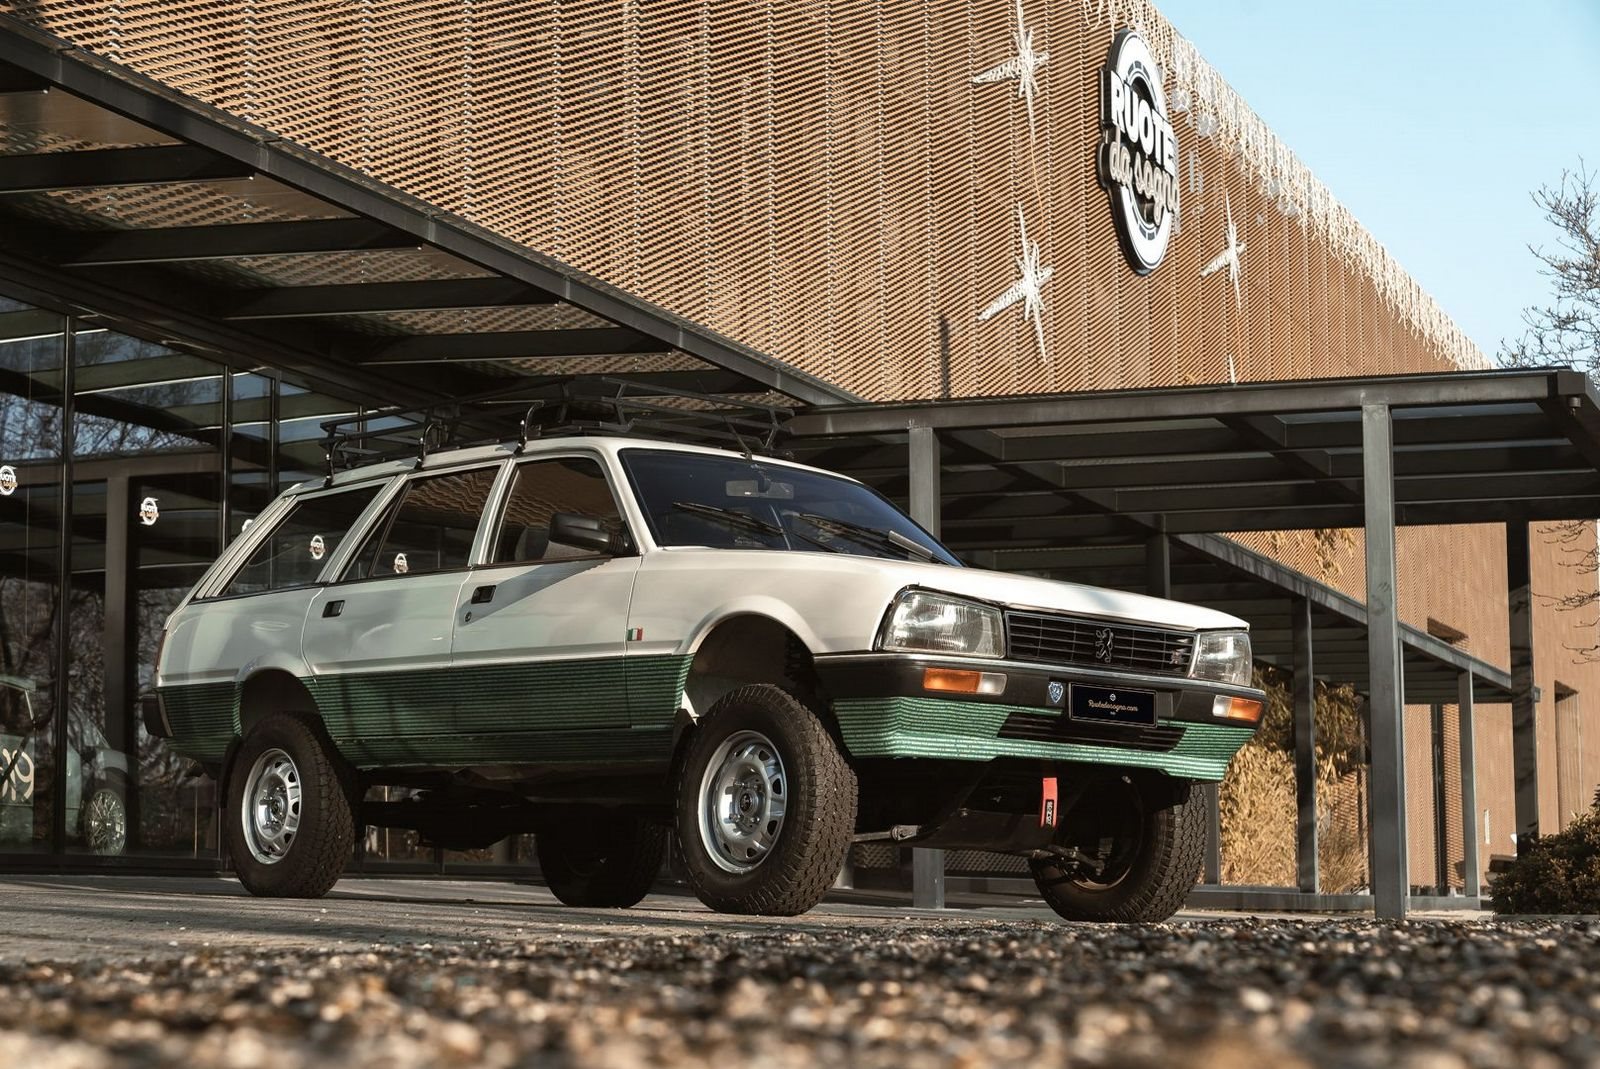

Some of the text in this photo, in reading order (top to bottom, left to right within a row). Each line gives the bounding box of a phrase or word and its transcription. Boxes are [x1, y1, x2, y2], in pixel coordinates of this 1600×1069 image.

[1110, 70, 1176, 177] RUOTE
[1110, 126, 1180, 226] da sogno
